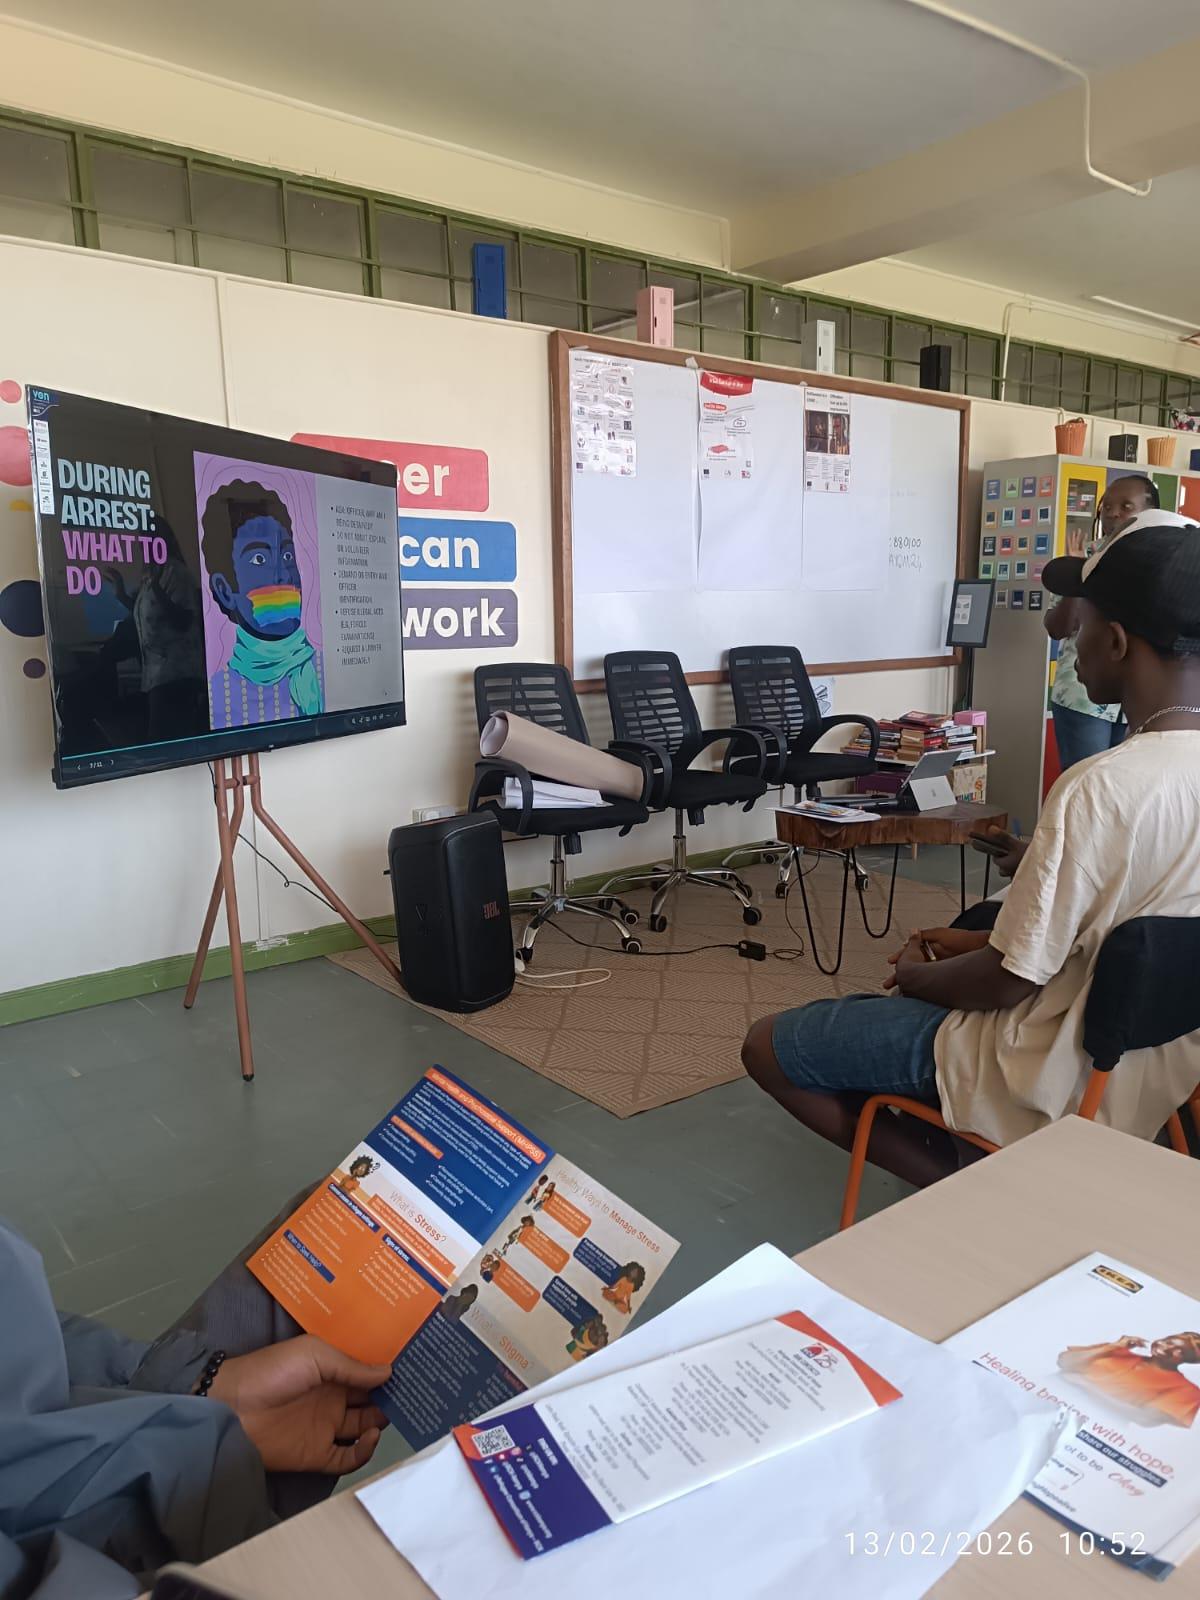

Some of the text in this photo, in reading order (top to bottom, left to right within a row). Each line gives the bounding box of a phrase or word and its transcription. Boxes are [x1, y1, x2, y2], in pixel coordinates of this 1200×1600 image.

[58, 459, 150, 498] DURING
[388, 460, 449, 496] er
[61, 495, 155, 531] ARREST:
[62, 530, 167, 565] WHAT TO
[400, 535, 480, 569] can
[66, 566, 102, 596] DO
[483, 901, 500, 919] JBL
[414, 1214, 446, 1243] Stress?
[600, 1204, 610, 1214] to
[608, 1210, 636, 1236] Manage
[635, 1230, 662, 1254] Stress
[1098, 1268, 1137, 1290] IKEA
[979, 1352, 1036, 1391] Healing
[1092, 1422, 1126, 1447] with
[1128, 1444, 1175, 1479] hope.
[1077, 1450, 1088, 1462] to
[1088, 1458, 1103, 1471] be
[1078, 1431, 1162, 1485] share our struggles.
